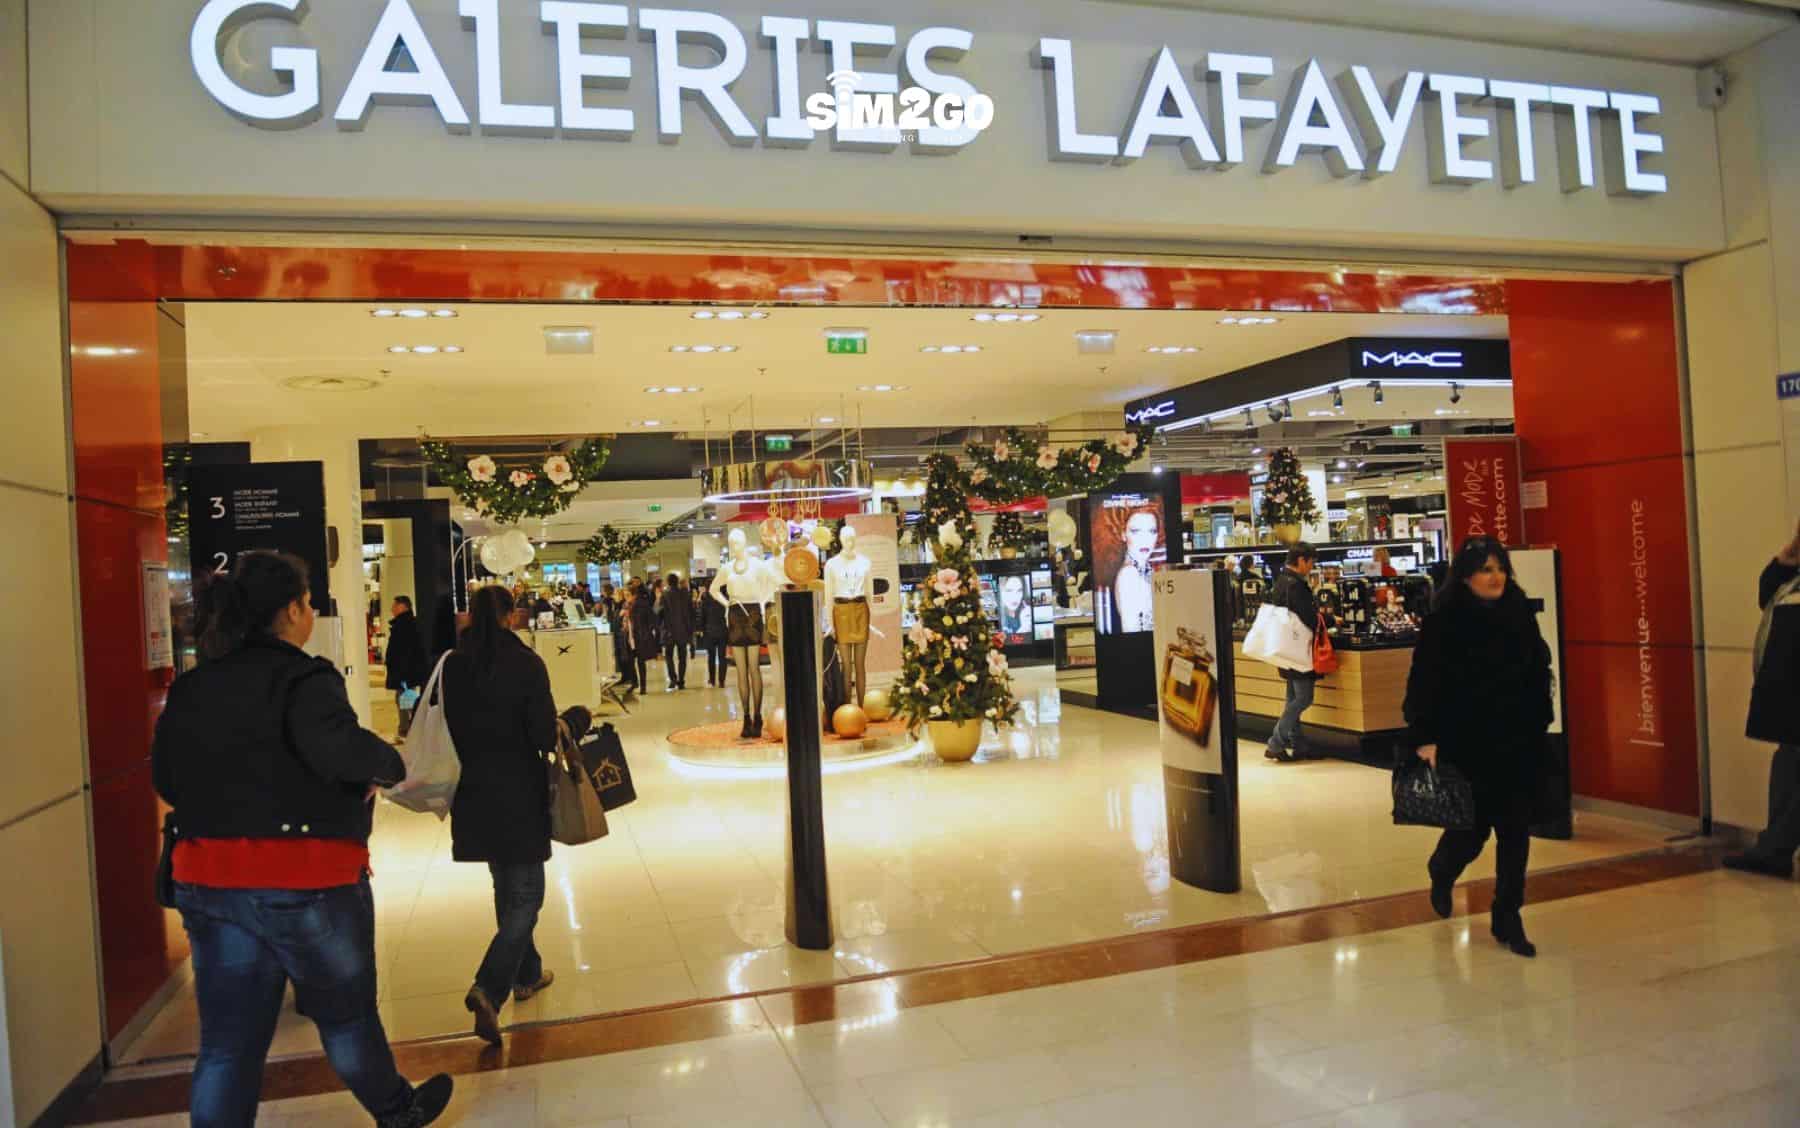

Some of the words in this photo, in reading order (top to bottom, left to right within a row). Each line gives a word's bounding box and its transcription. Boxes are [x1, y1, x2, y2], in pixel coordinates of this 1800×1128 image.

[190, 0, 980, 148] GALERIES
[1037, 36, 1667, 194] LAFAYETTE
[210, 496, 225, 519] 3
[213, 551, 229, 575] 2
